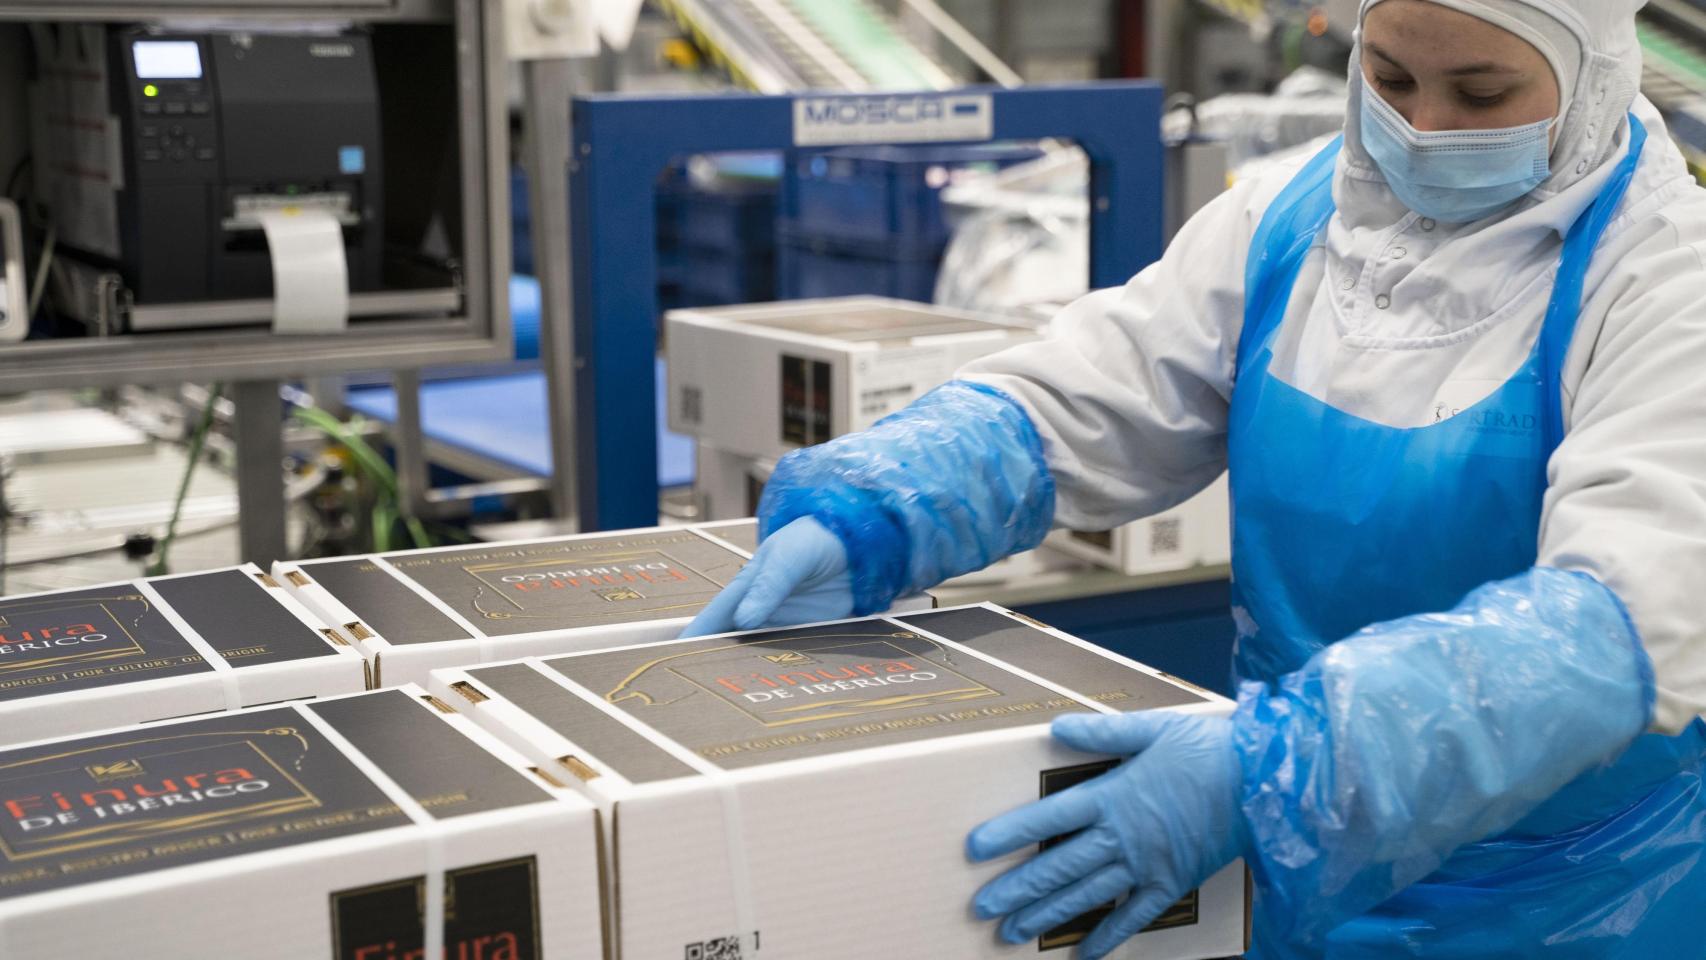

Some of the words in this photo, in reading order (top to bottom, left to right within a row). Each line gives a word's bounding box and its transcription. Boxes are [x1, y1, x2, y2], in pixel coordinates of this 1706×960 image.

[805, 100, 942, 124] MOSCA
[0, 675, 56, 689] ORIGEN
[70, 669, 105, 679] OUR
[182, 655, 204, 664] OU
[716, 659, 918, 694] Finura
[742, 688, 794, 703] DE
[5, 767, 255, 819] Finura
[18, 811, 80, 832] DE
